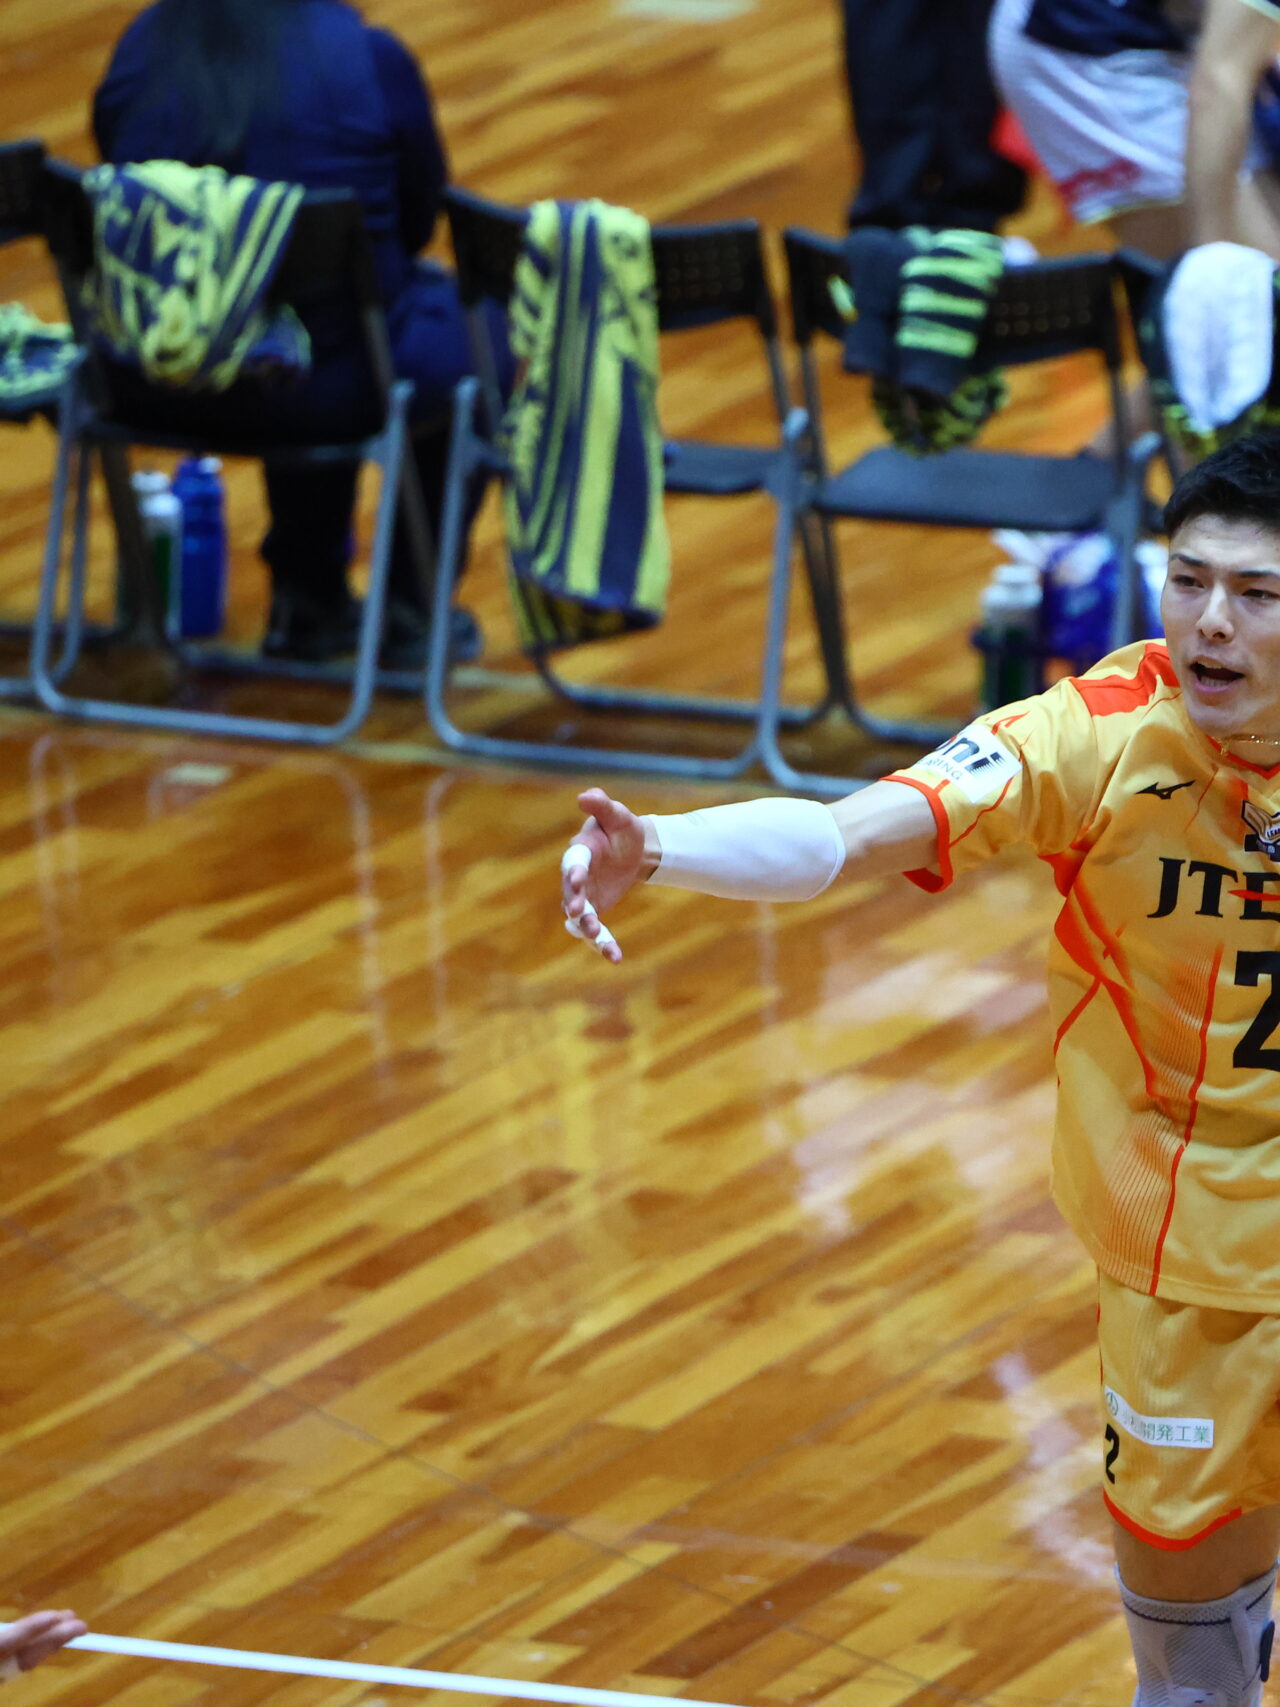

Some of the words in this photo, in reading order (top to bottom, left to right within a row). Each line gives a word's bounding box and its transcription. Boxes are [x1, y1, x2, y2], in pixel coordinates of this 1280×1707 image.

[936, 735, 1003, 773] ni
[1127, 1412, 1211, 1443] 開発工業
[1105, 1423, 1120, 1485] 2
